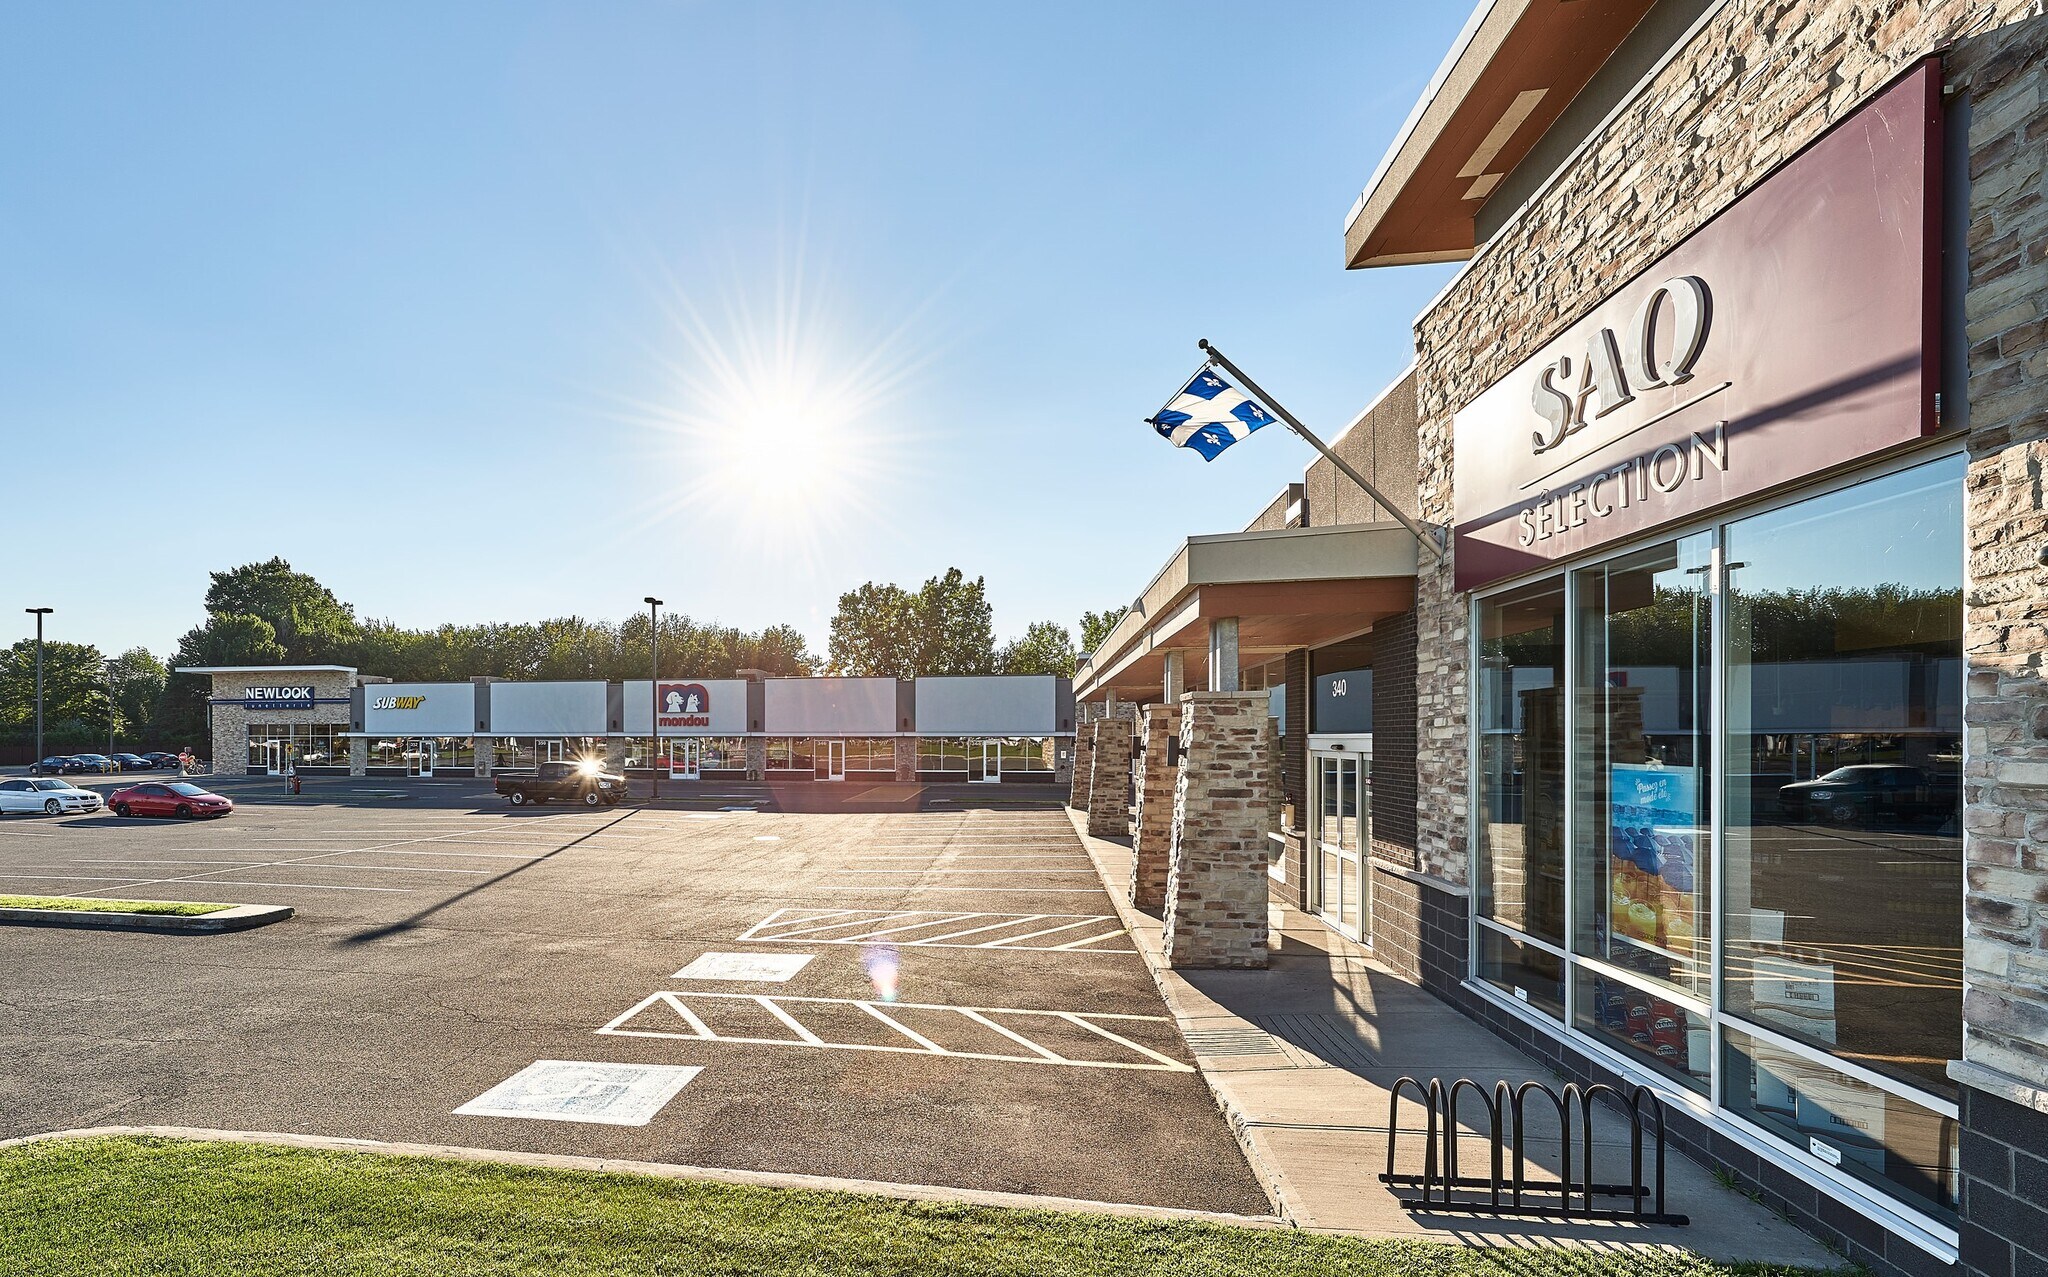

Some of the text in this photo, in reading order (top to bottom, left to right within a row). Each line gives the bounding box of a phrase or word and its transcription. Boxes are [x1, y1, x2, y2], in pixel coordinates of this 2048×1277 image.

[1531, 275, 1713, 455] SAQ
[1518, 419, 1729, 547] SÉLECTION
[245, 687, 312, 699] NEWLOOK
[1332, 678, 1347, 698] 340
[372, 695, 427, 710] SUBWAY
[658, 714, 709, 727] mondou
[1636, 779, 1667, 794] Passez en
